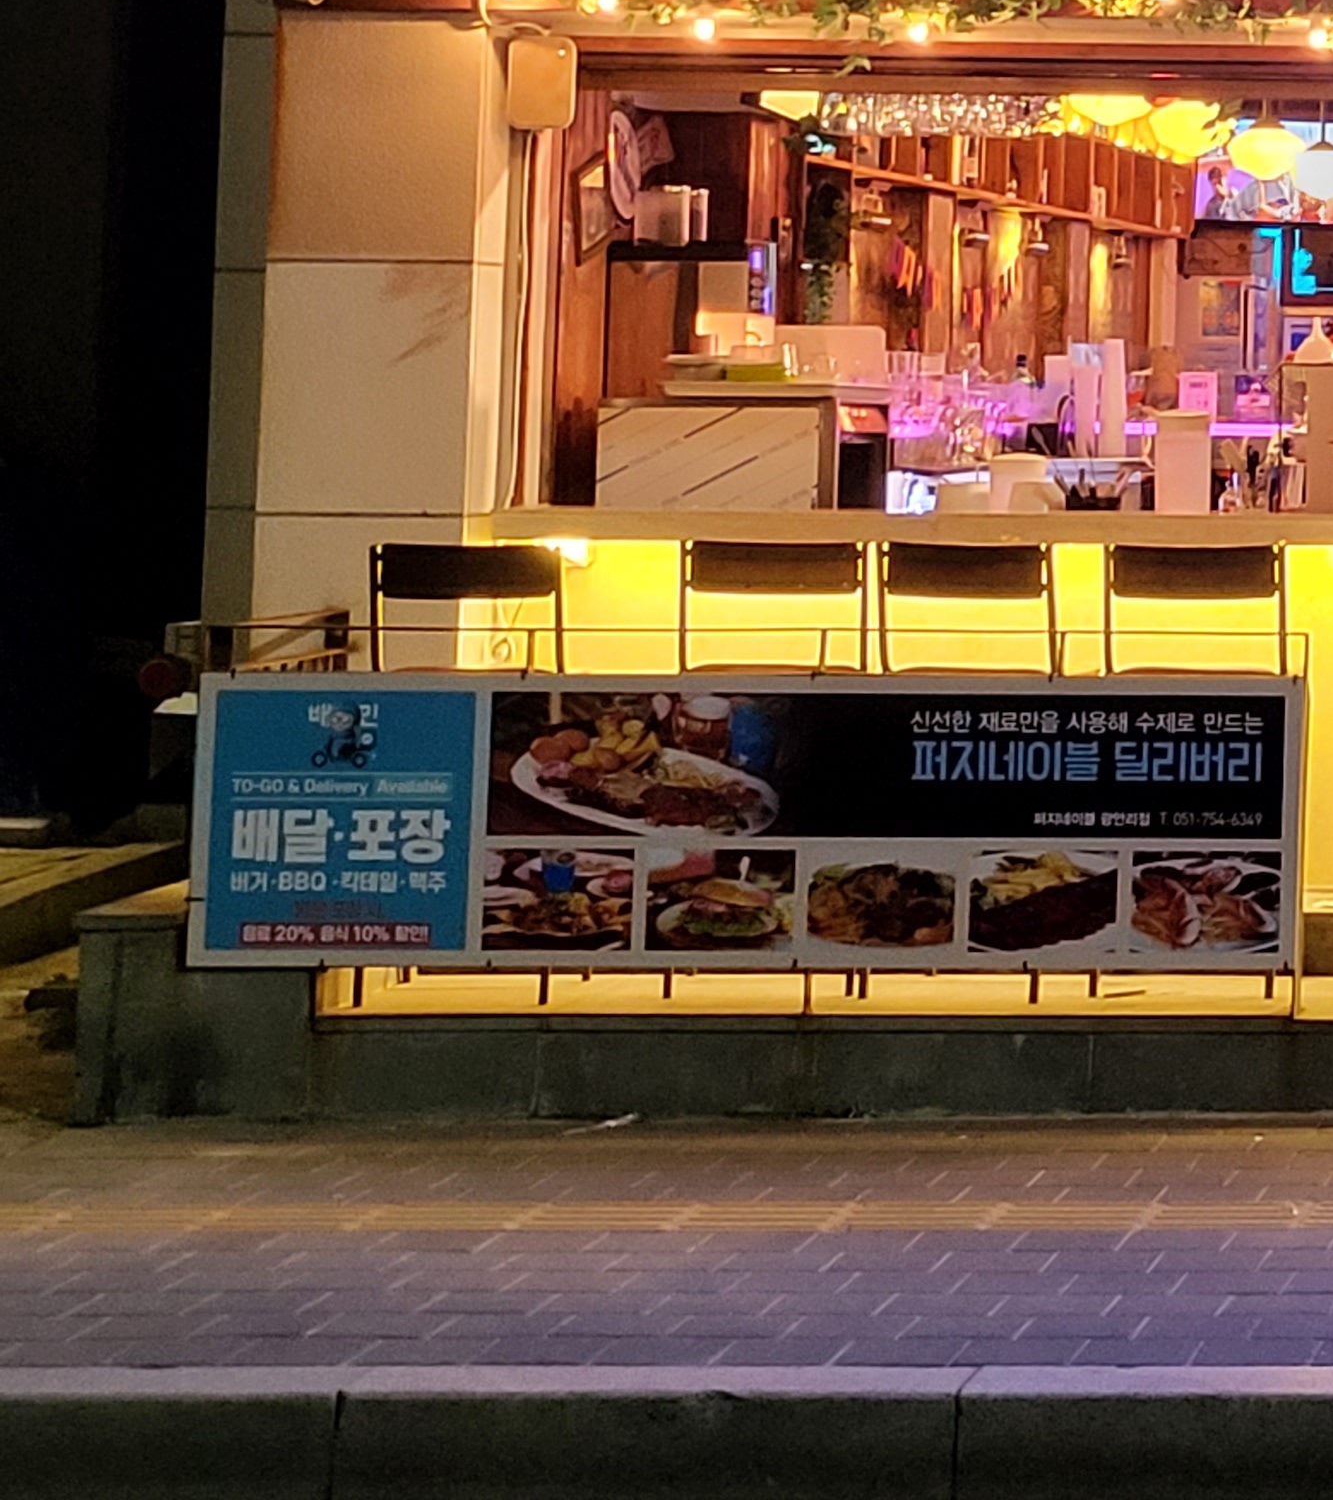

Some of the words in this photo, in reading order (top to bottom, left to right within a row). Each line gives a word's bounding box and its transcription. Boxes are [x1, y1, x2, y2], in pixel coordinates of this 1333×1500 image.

[910, 710, 972, 734] 신선한
[977, 710, 1060, 734] 재료만을
[1065, 710, 1129, 734] 사용해
[1134, 710, 1196, 734] 수제로
[1202, 711, 1265, 735] 만드는
[910, 740, 1101, 782] 퍼지네이블
[1114, 740, 1263, 782] 딜리버리
[231, 778, 284, 794] TO-GO
[287, 778, 299, 794] &
[303, 778, 369, 797] Delivery
[376, 778, 448, 794] Available
[274, 924, 315, 943] 20%
[353, 924, 390, 943] 10%
